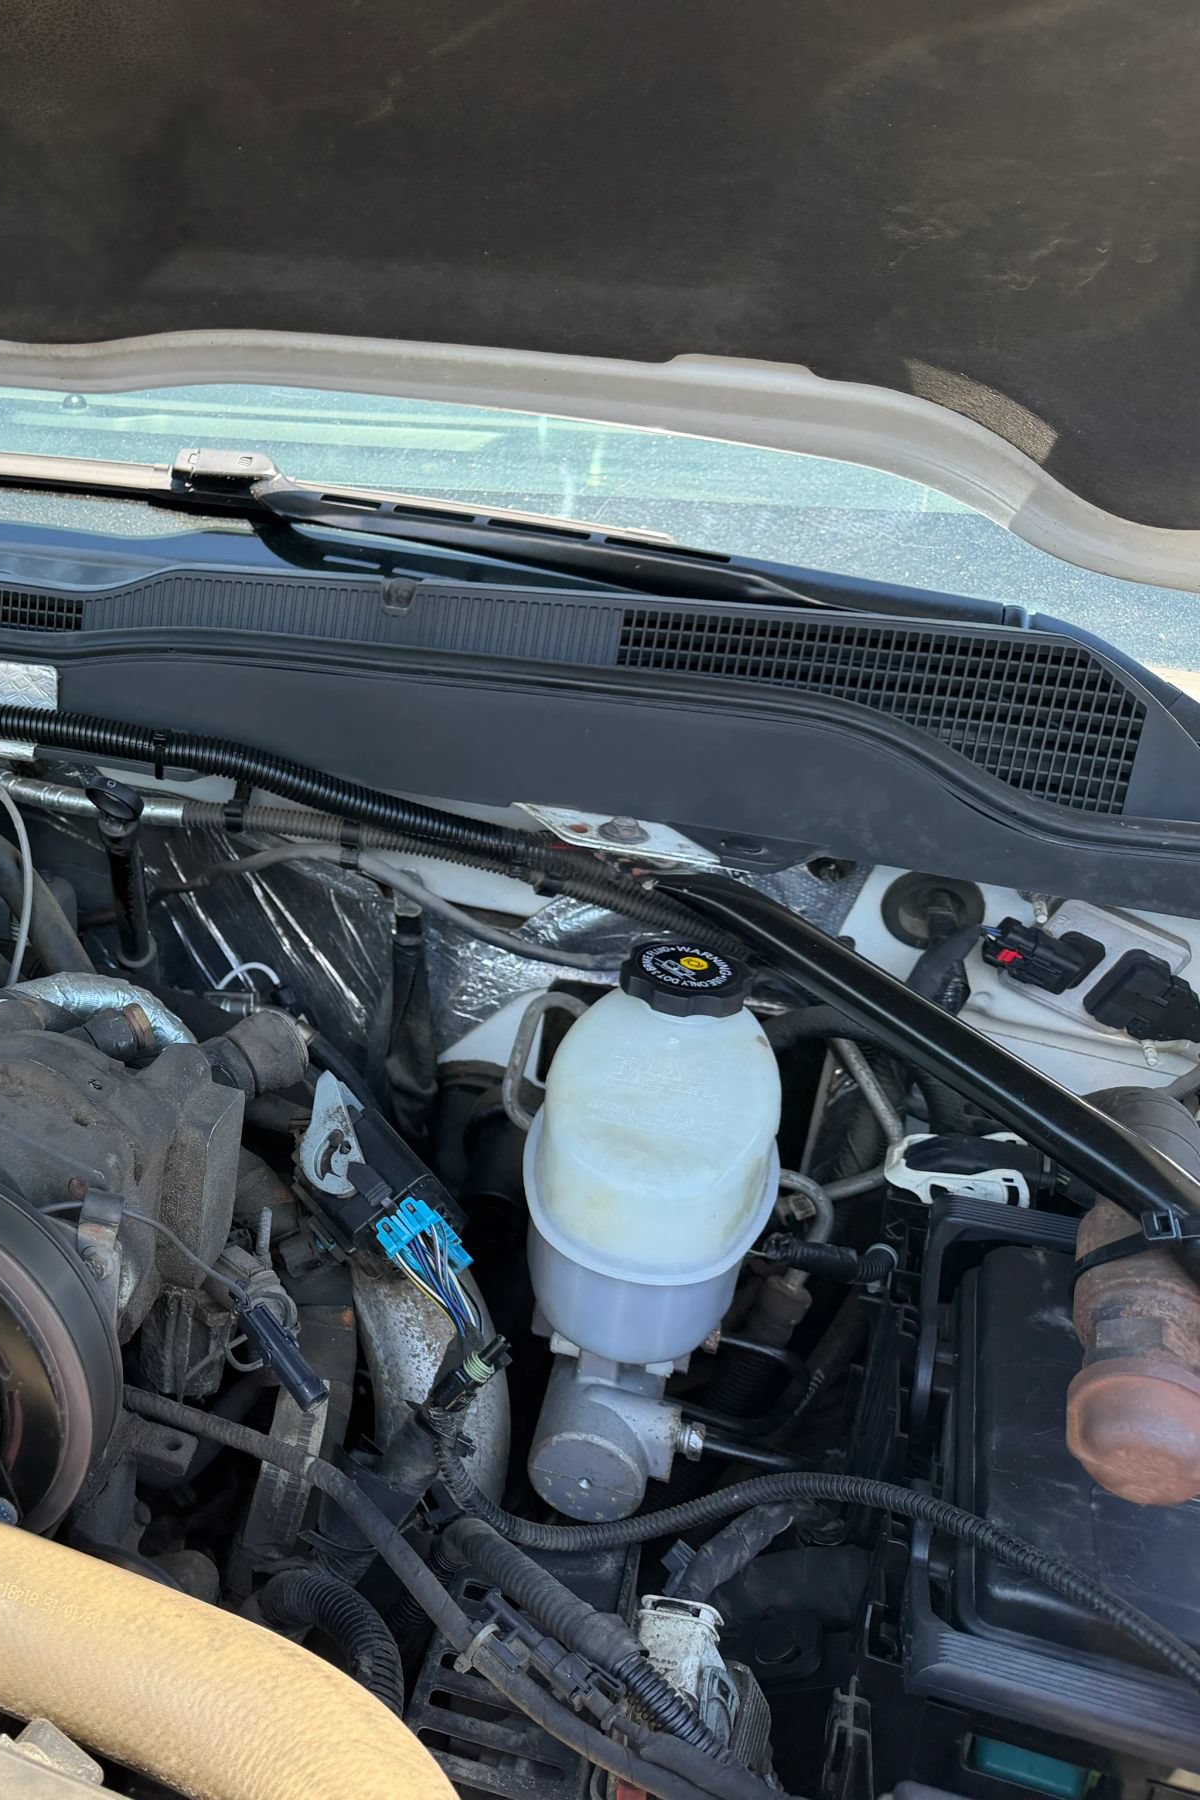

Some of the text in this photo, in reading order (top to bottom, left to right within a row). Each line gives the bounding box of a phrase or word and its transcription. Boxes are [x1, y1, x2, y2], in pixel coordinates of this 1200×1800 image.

[645, 946, 671, 957] FLUID
[641, 954, 657, 972] BRAKE
[676, 945, 732, 975] WARNING
[656, 974, 680, 985] DOT
[681, 980, 709, 988] ONLY
[708, 977, 727, 987] USE
